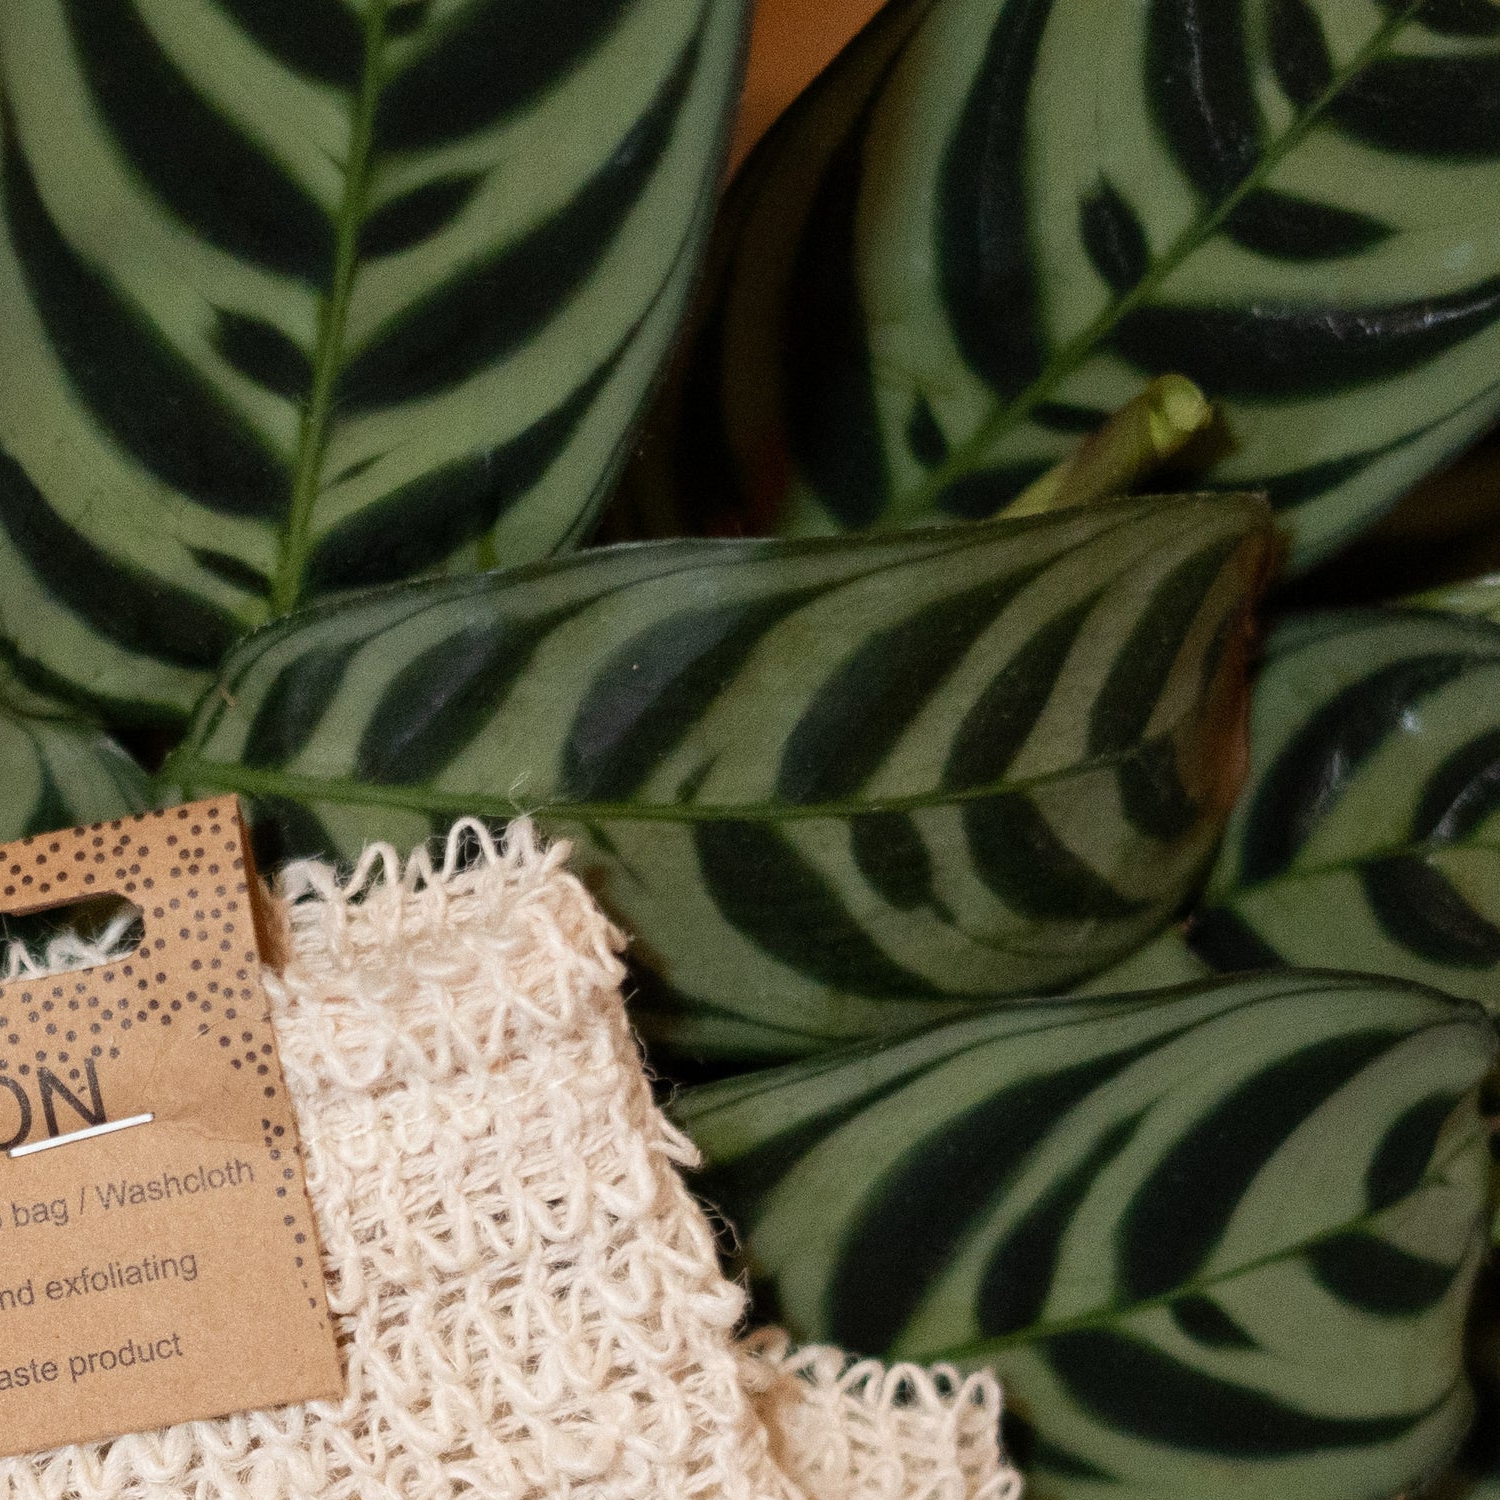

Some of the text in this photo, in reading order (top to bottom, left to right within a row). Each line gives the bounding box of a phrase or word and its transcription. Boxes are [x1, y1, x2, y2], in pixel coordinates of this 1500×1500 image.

[11, 1197, 69, 1227] bag
[78, 1184, 88, 1216] /
[96, 1158, 256, 1210] Washcloth
[45, 1253, 199, 1302] exfoliating
[68, 1333, 183, 1382] product
